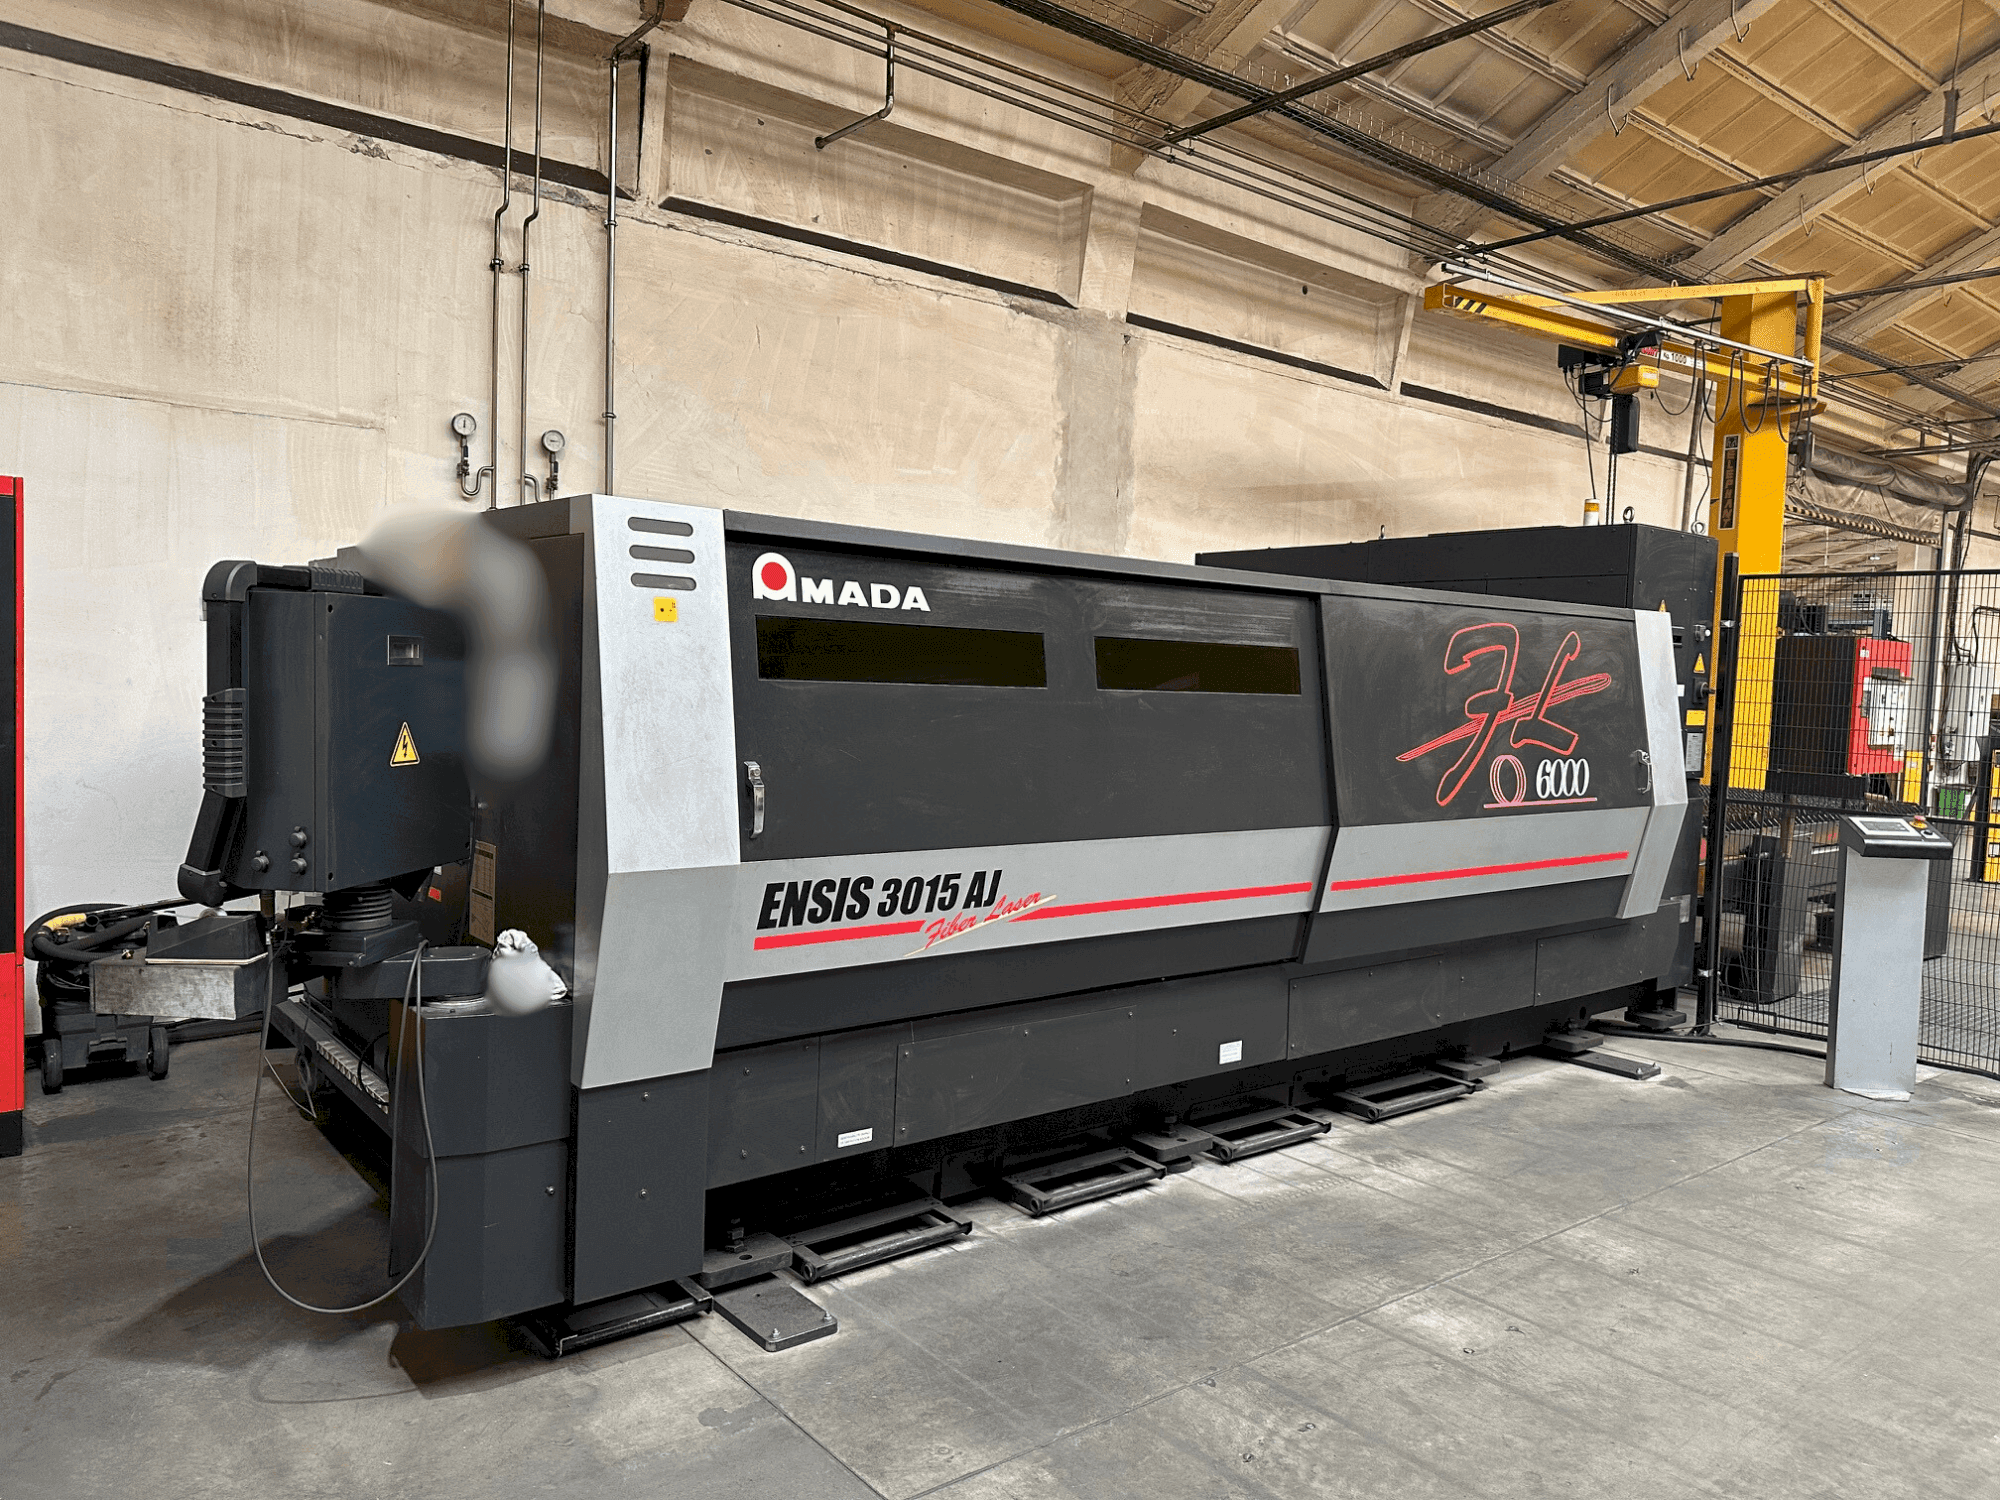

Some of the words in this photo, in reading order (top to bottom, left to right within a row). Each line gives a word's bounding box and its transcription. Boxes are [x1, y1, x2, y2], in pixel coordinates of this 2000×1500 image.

[1671, 353, 1687, 365] 1000
[1722, 449, 1736, 527] ELEPHANT
[752, 552, 931, 612] AMADA
[1535, 758, 1590, 799] 6000
[756, 876, 875, 930] ENSIS
[876, 873, 963, 917] 3015
[962, 869, 1003, 909] AJ
[924, 912, 978, 949] Fiber
[983, 892, 1042, 922] Laser
